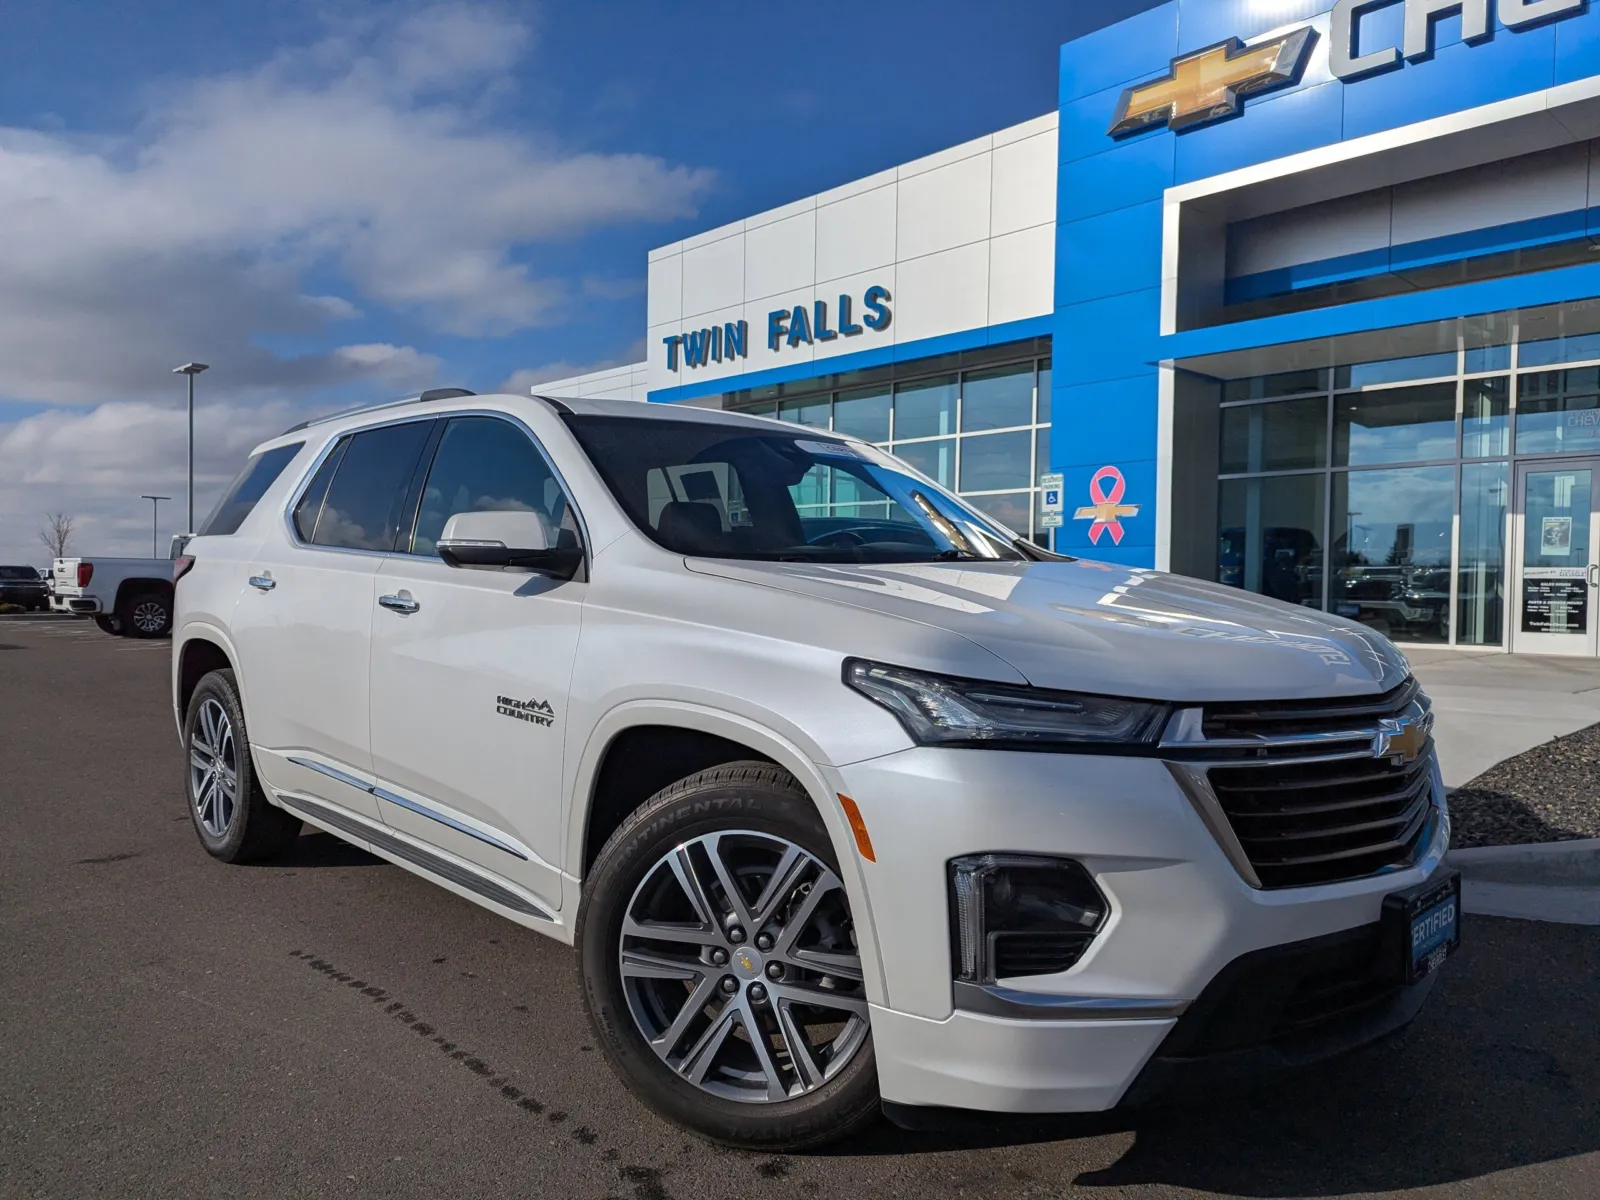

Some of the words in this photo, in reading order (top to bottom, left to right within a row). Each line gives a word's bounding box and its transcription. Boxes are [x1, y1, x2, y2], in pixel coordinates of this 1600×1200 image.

[1329, 0, 1588, 82] CH
[663, 320, 748, 373] TWIN
[768, 285, 892, 353] FALLS
[496, 695, 526, 710] HIGH
[496, 705, 554, 728] COUNTRY
